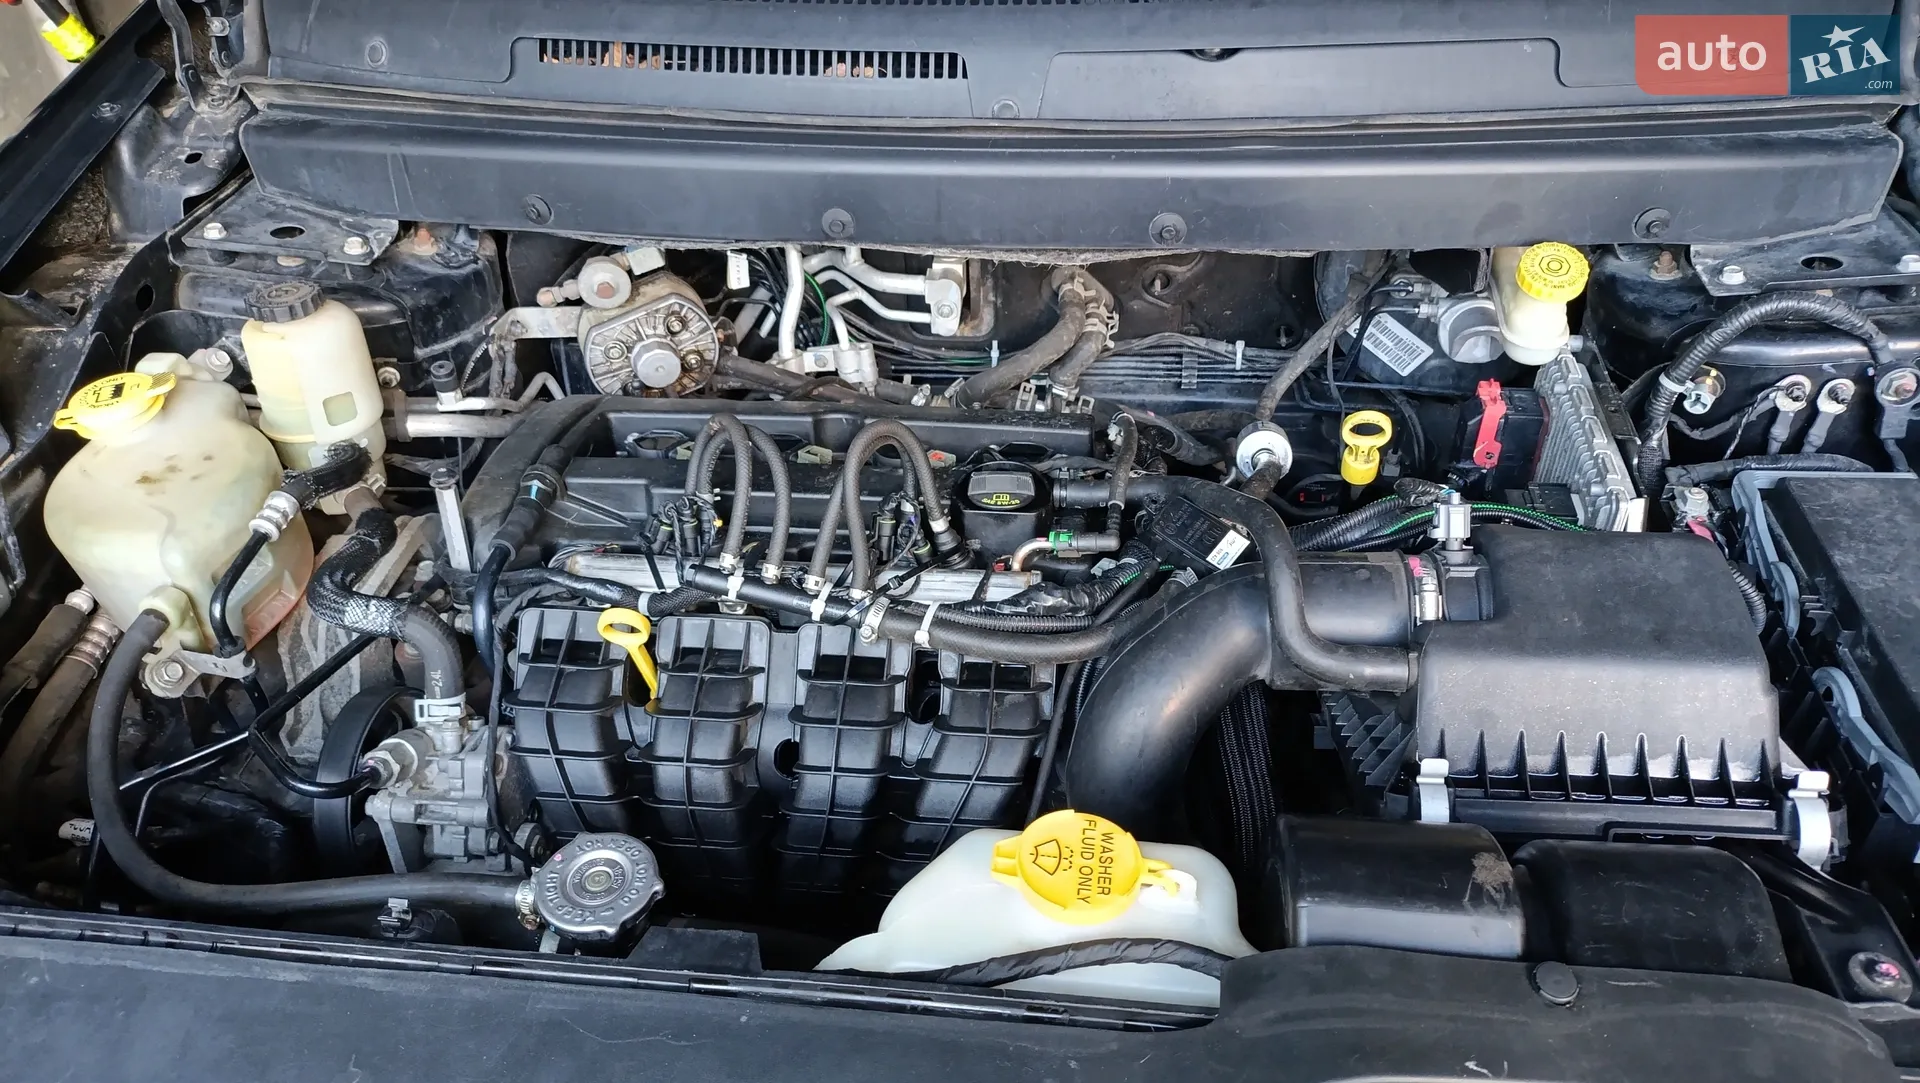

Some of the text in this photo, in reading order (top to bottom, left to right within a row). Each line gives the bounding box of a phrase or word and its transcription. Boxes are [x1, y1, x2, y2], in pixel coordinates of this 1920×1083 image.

[545, 838, 647, 922] KEEP TIGHT DO NOT OPEN HOT
[1077, 819, 1097, 904] FLUID ONLY
[1097, 832, 1114, 896] WASHER
